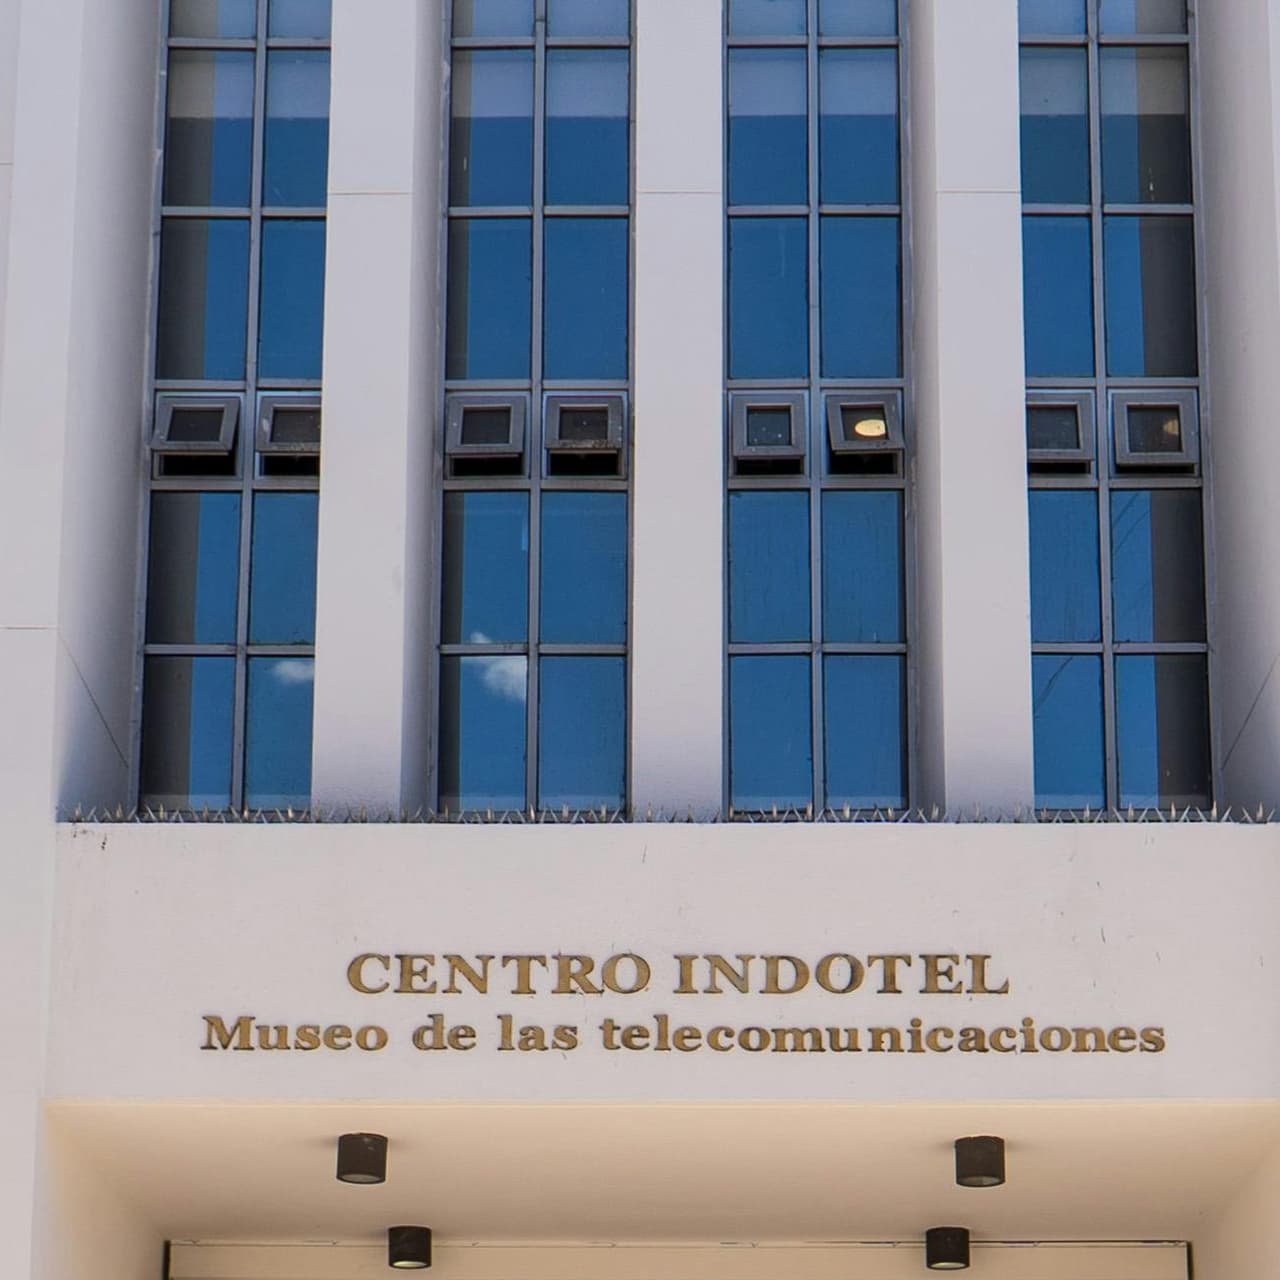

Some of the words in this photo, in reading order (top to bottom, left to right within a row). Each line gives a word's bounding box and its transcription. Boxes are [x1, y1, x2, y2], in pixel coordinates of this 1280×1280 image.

[346, 952, 651, 996] CENTRO
[672, 952, 1010, 996] INDOTEL
[201, 1014, 388, 1052] Museo
[412, 1014, 477, 1052] de
[497, 1013, 578, 1053] las
[600, 1013, 1167, 1056] telecomunicaciones
